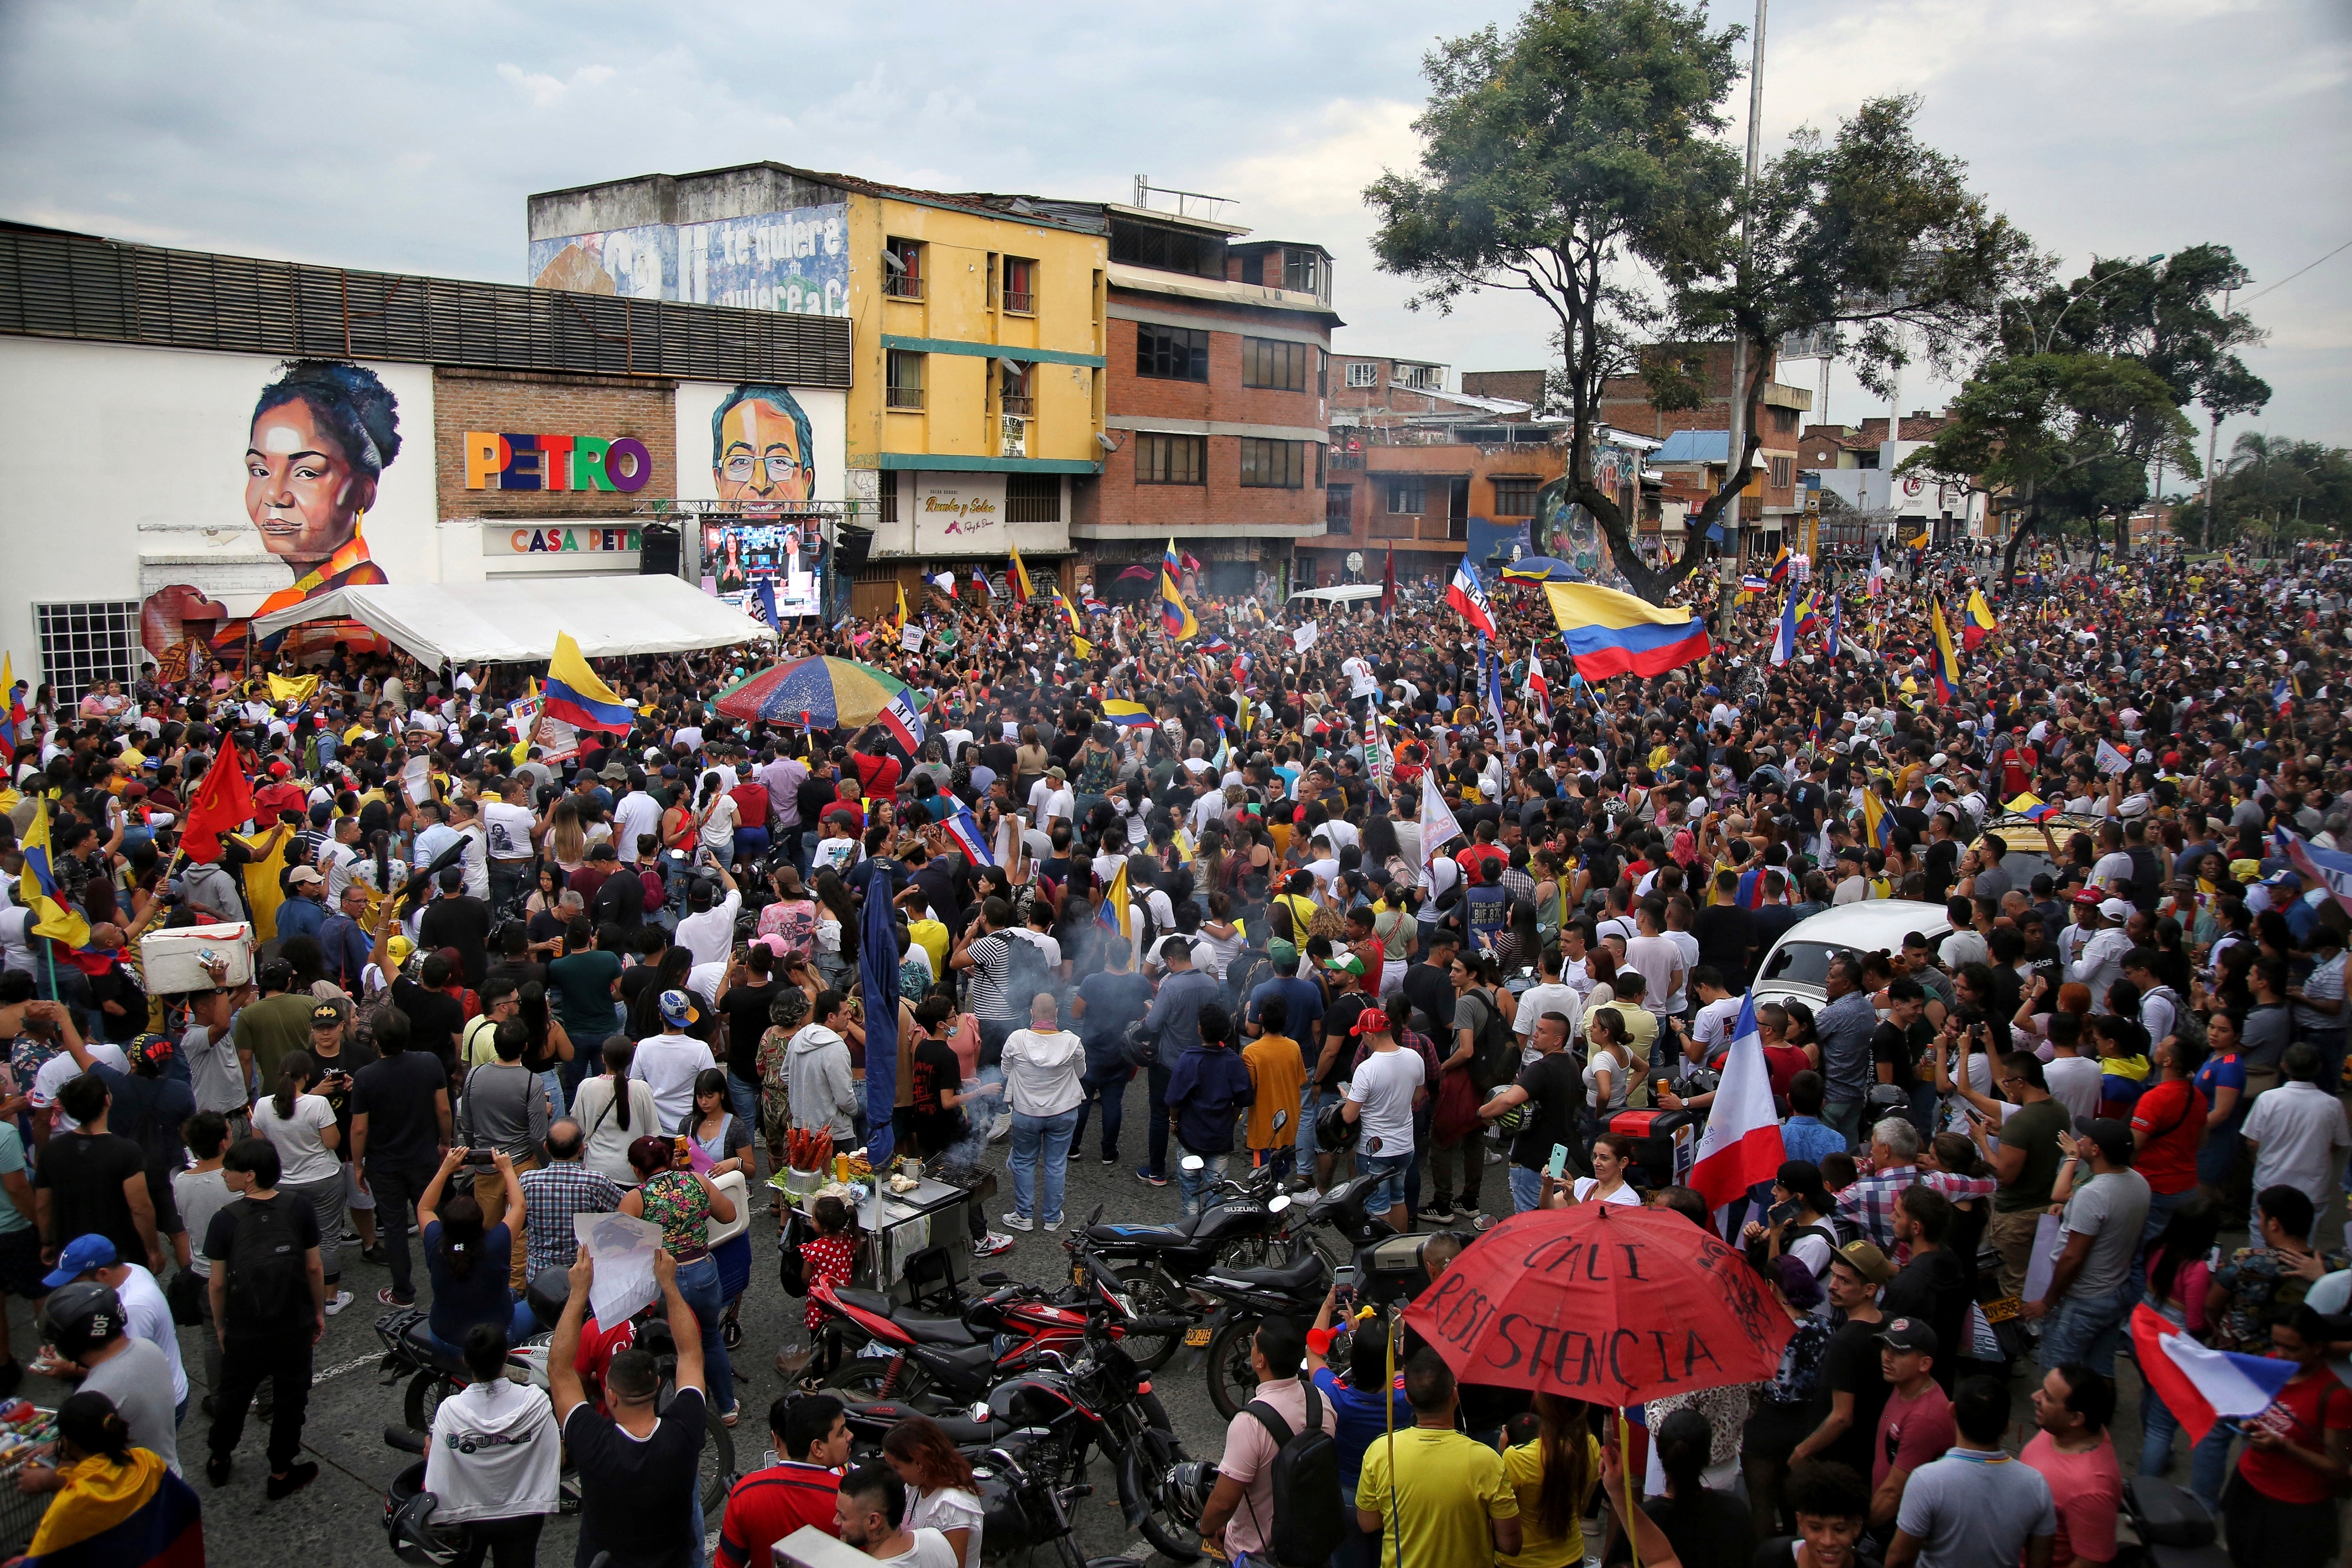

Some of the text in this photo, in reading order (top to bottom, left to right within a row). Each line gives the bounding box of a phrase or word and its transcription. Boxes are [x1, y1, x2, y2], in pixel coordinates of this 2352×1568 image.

[722, 223, 750, 266] te
[755, 214, 840, 271] quiere
[464, 416, 652, 492] PETRO
[926, 496, 996, 517] Rumba y Salsa
[510, 528, 641, 552] CASA PETR
[952, 563, 989, 575] ESCUA
[1465, 582, 1489, 614] M-19
[515, 697, 545, 719] PETR
[893, 702, 907, 718] M
[1474, 909, 1486, 919] BWF
[1675, 1125, 1690, 1186] PET
[1523, 1235, 1649, 1282] CALI
[91, 1314, 109, 1336] BOF
[529, 1349, 549, 1359] Comba
